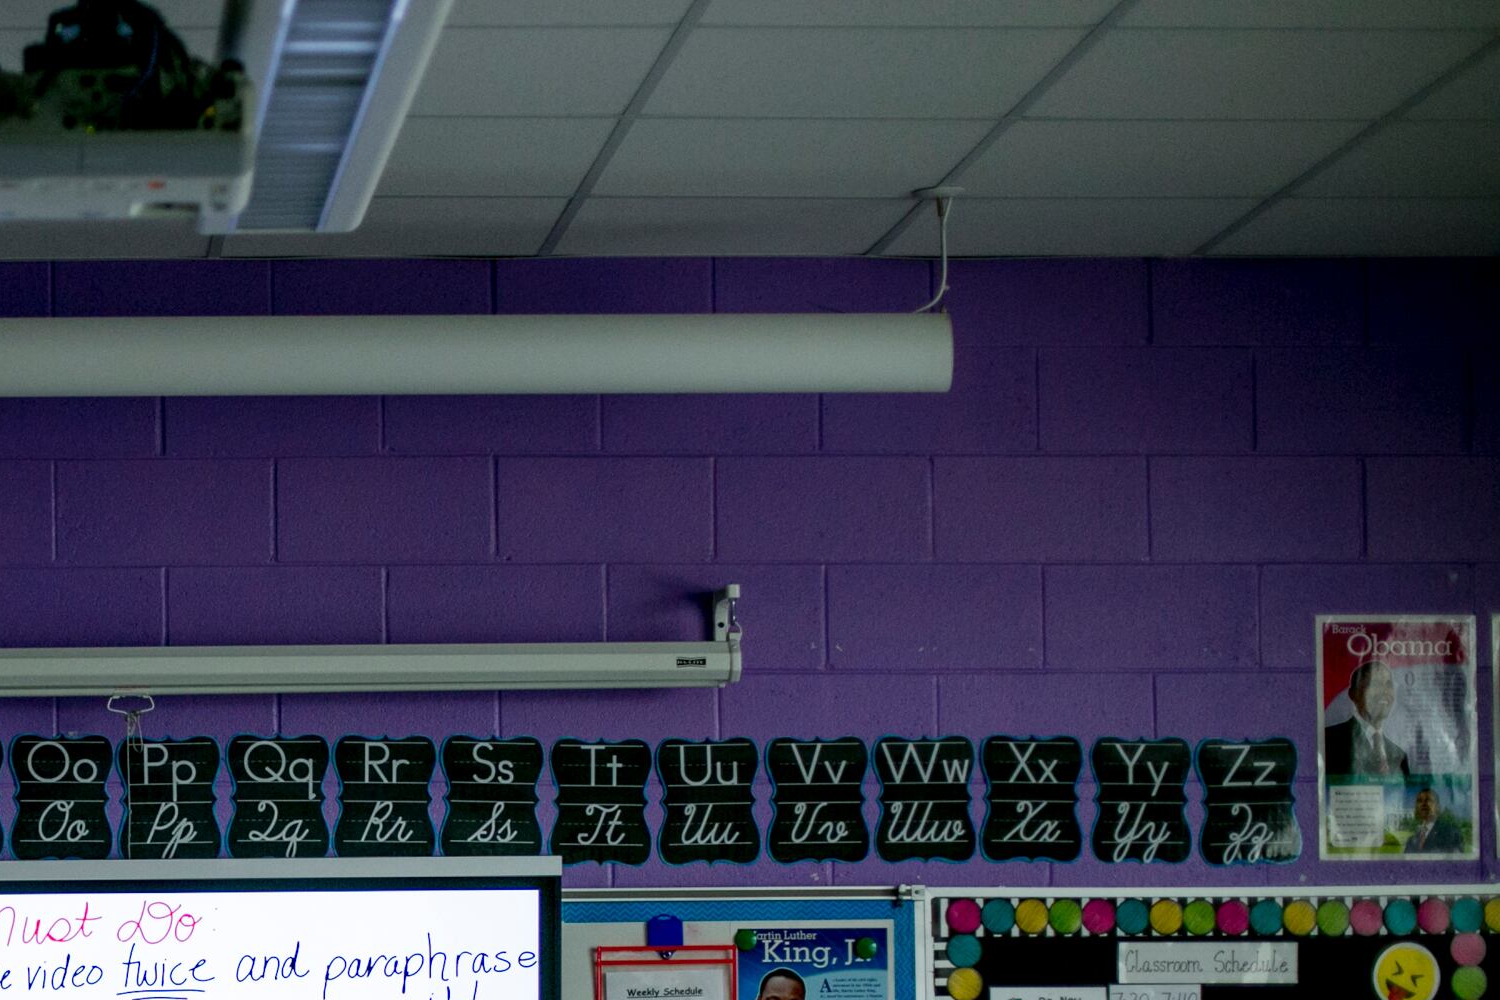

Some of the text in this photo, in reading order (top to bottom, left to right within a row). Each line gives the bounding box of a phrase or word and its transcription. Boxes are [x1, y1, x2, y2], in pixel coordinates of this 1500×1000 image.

[1332, 625, 1366, 634] Barack
[1347, 633, 1452, 657] Obama
[244, 742, 316, 799] Qq
[472, 743, 515, 784] Ss
[678, 744, 740, 787] Uu
[880, 742, 969, 785] Ww
[117, 900, 202, 944] Do
[783, 930, 817, 940] Luther
[761, 939, 838, 967] King,
[1125, 950, 1289, 973] Classroom Schedule
[27, 954, 102, 991] video
[121, 943, 215, 988] twice
[236, 941, 309, 982] and
[323, 932, 537, 1000] paraphrase
[627, 986, 703, 997] Weekly Schedule
